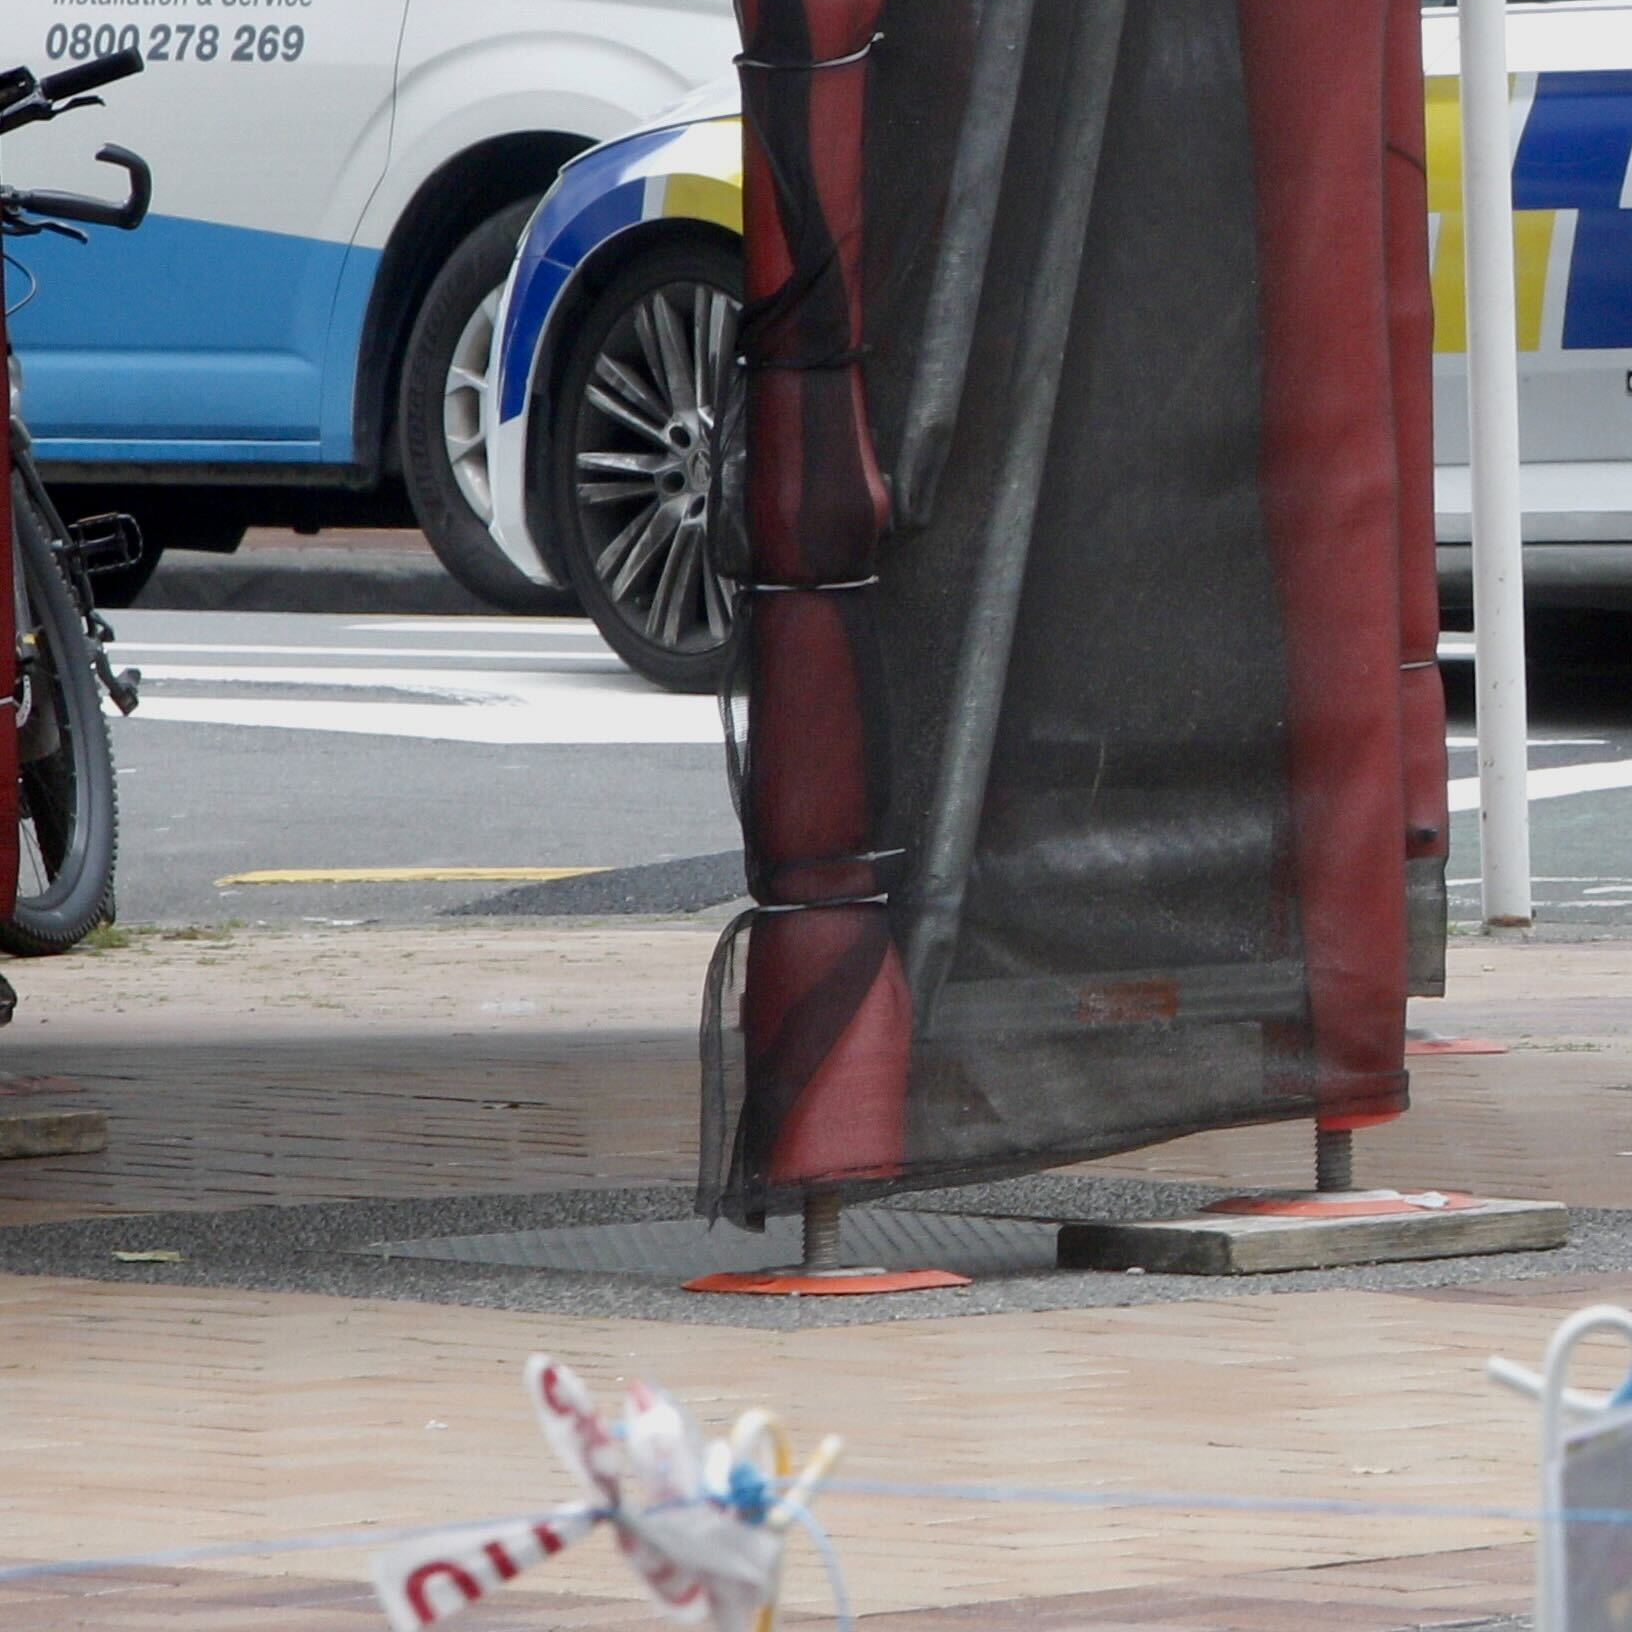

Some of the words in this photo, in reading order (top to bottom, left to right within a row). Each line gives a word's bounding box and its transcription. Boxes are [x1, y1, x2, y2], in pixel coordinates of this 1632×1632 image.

[45, 23, 140, 60] 0800
[147, 24, 220, 62] 278
[231, 25, 305, 63] 269
